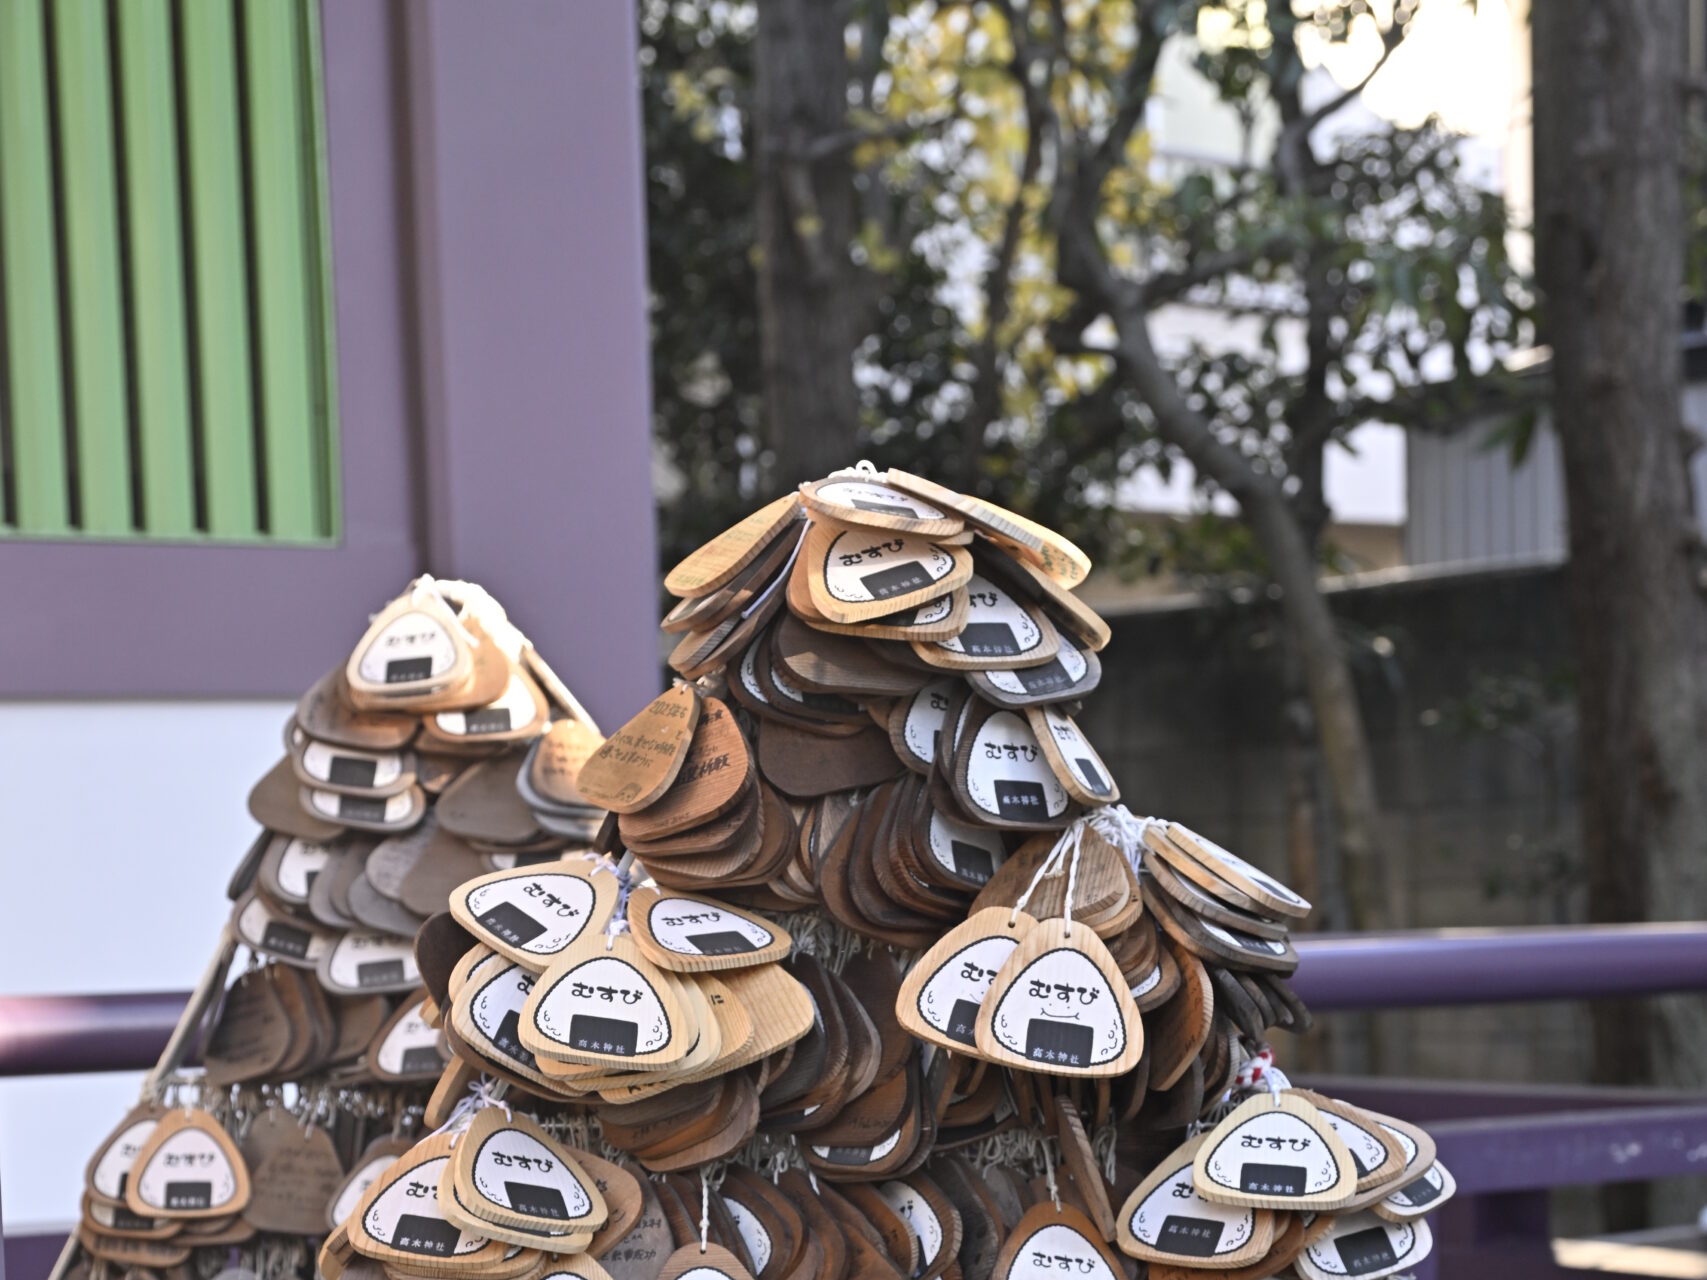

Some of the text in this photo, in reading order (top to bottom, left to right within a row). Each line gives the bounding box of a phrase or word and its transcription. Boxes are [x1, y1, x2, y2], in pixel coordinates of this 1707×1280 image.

[839, 538, 904, 566] むすび
[984, 741, 1038, 763] むすび
[523, 882, 580, 919] むすび
[661, 910, 721, 927] むすび
[571, 981, 644, 1005] むすび
[1028, 978, 1100, 1006] むすび
[577, 1038, 626, 1055] 高木神社
[1032, 1047, 1080, 1065] 高木神社
[1241, 1133, 1311, 1153] むすび
[491, 1150, 555, 1174] むすび
[1248, 1181, 1295, 1194] 高木神社
[399, 1234, 446, 1251] 高木神社
[1032, 1250, 1096, 1274] むすび
